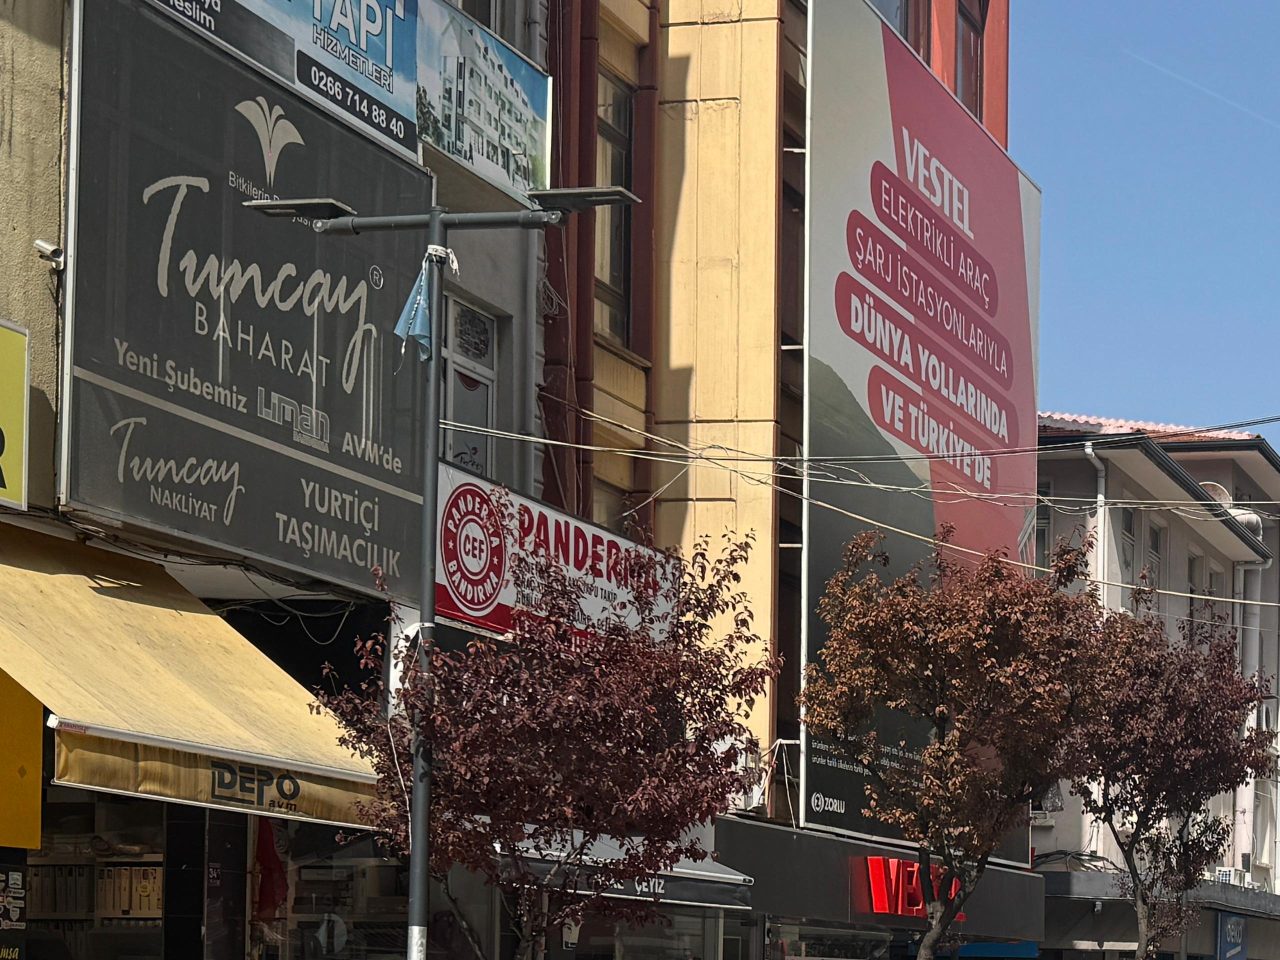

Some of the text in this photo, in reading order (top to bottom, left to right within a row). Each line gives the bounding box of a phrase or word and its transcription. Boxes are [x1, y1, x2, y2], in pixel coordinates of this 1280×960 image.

[313, 23, 394, 94] HİZMETLERİ
[311, 66, 405, 139] 0266 714 88 40
[901, 125, 974, 240] VESTEL
[143, 175, 377, 394] Tuncay
[880, 180, 991, 310] ELEKTRİKLİ ARAÇ
[855, 227, 1009, 380] ŞARJ İSTASYONLARIYLA
[194, 301, 331, 388] BAHARAT
[850, 293, 1010, 445] DÜNYA YOLLARINDA
[114, 337, 159, 380] Yeni
[165, 358, 248, 414] Şubemiz
[341, 431, 402, 474] AVM'de
[880, 384, 992, 490] VE TÜRKİYE'DE
[110, 417, 246, 527] Tuncay
[150, 485, 218, 523] NAKLİYAT
[300, 478, 380, 537] YURTİÇİ
[275, 512, 401, 578] TAŞIMACILIK
[448, 559, 499, 604] BANDIRMA
[463, 533, 485, 561] CEF
[211, 760, 301, 807] DEPO
[824, 797, 846, 814] ZORLU
